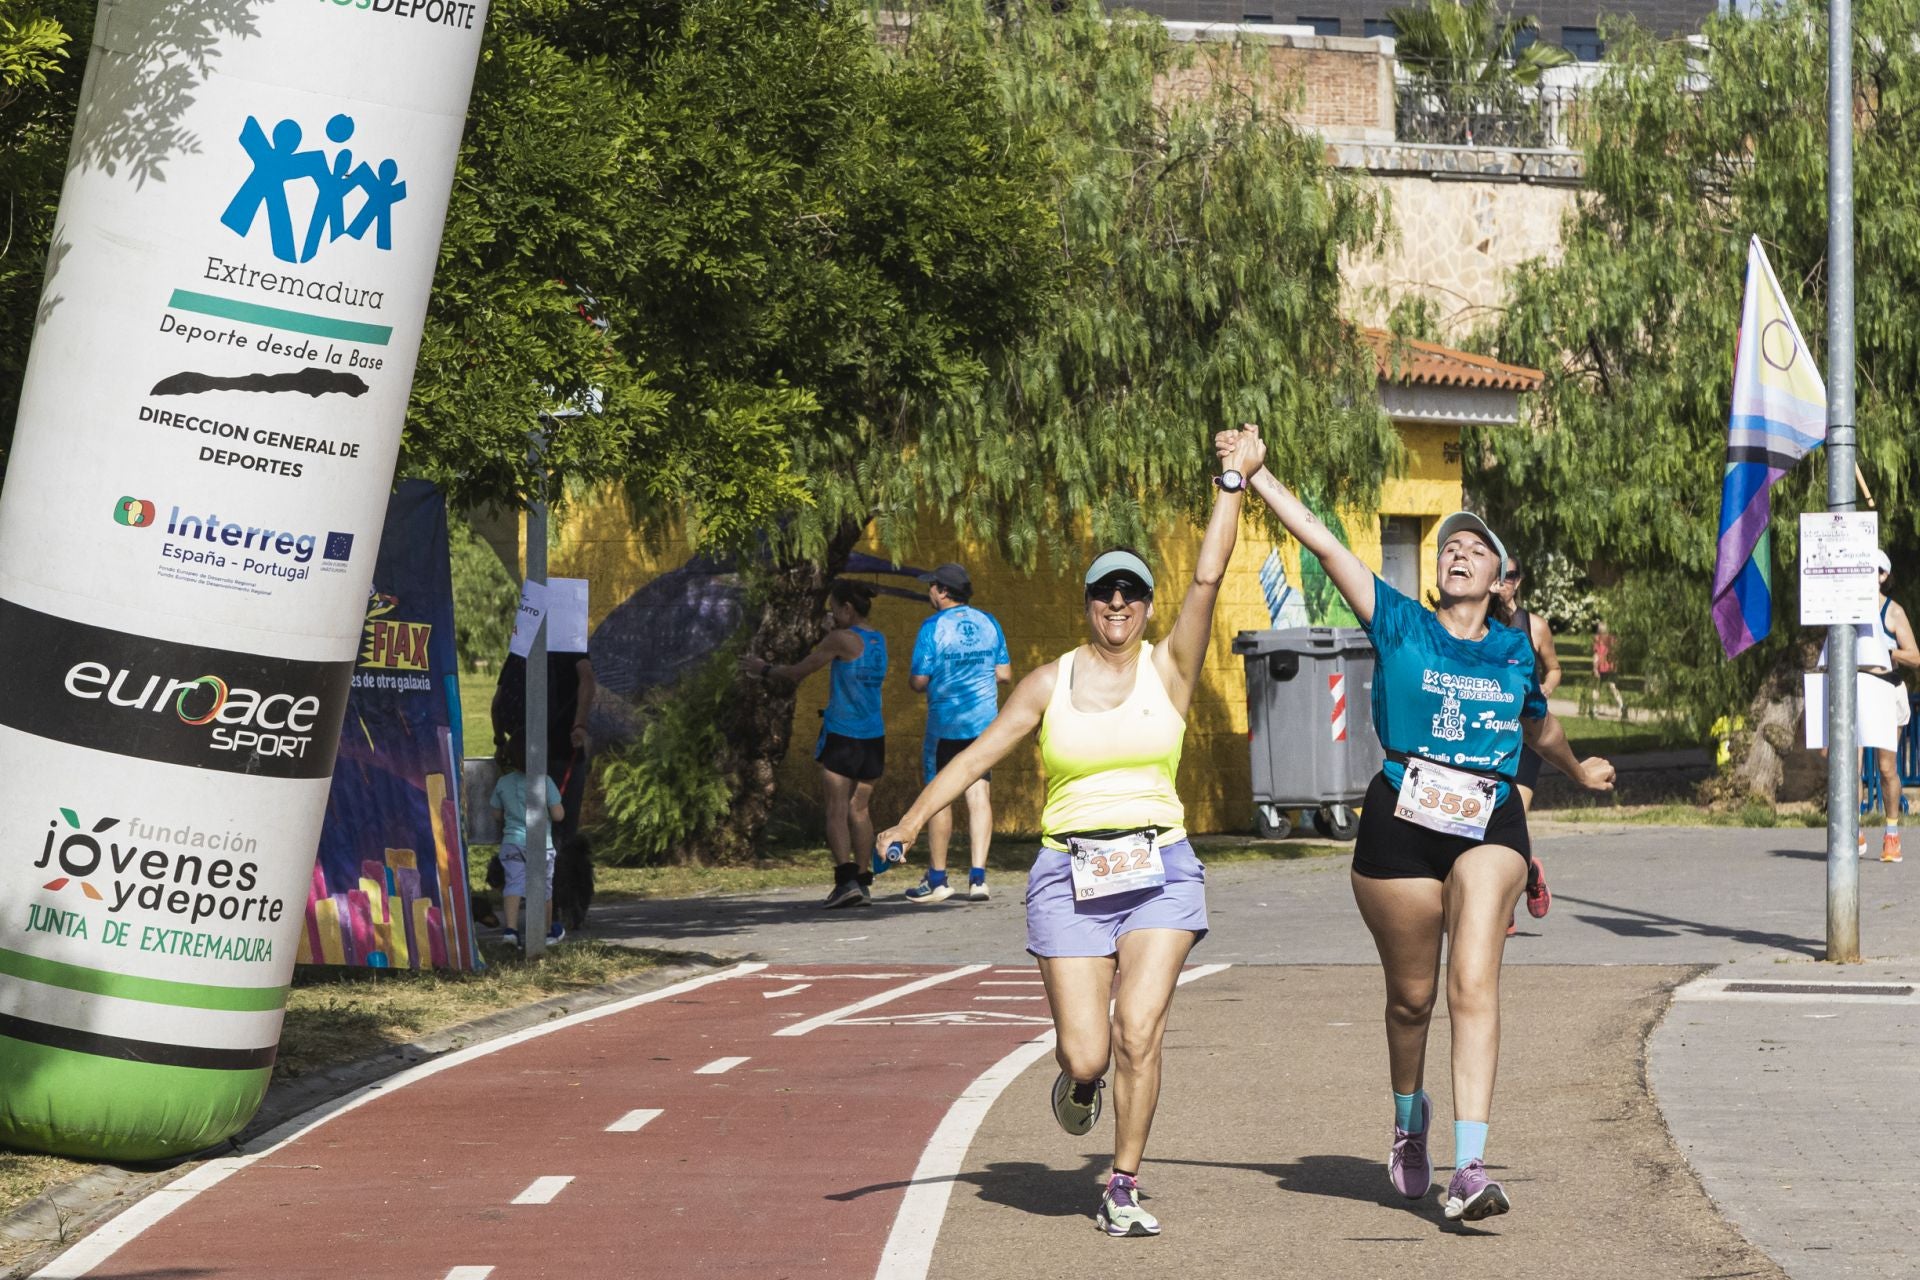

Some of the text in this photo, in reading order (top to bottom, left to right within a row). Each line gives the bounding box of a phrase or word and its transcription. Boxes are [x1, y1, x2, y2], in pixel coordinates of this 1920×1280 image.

[204, 257, 384, 309] Extremadura
[160, 314, 383, 370] Deporte desde la Base
[139, 406, 359, 458] DIRECCION GENERAL DE
[199, 446, 303, 477] DEPORTES
[167, 506, 316, 562] Interreg
[162, 543, 226, 567] España
[243, 559, 310, 581] Portugal
[373, 621, 430, 669] FLAX
[64, 661, 320, 732] euroace
[363, 672, 374, 688] de
[376, 674, 397, 689] otra
[397, 674, 431, 692] galaxia
[1423, 669, 1501, 691] IX CARRERA
[1458, 689, 1514, 703] DIVERSIDAD
[1441, 706, 1460, 718] pa
[1444, 716, 1460, 728] lo
[1485, 719, 1519, 733] aqualia
[209, 728, 312, 758] SPORT
[1432, 726, 1465, 741] m@s
[1418, 786, 1482, 819] 359
[128, 817, 257, 853] fundación
[1090, 848, 1152, 877] 322
[108, 879, 283, 924] ydeporte
[25, 904, 272, 962] JUNTA DE EXTREMADURA
